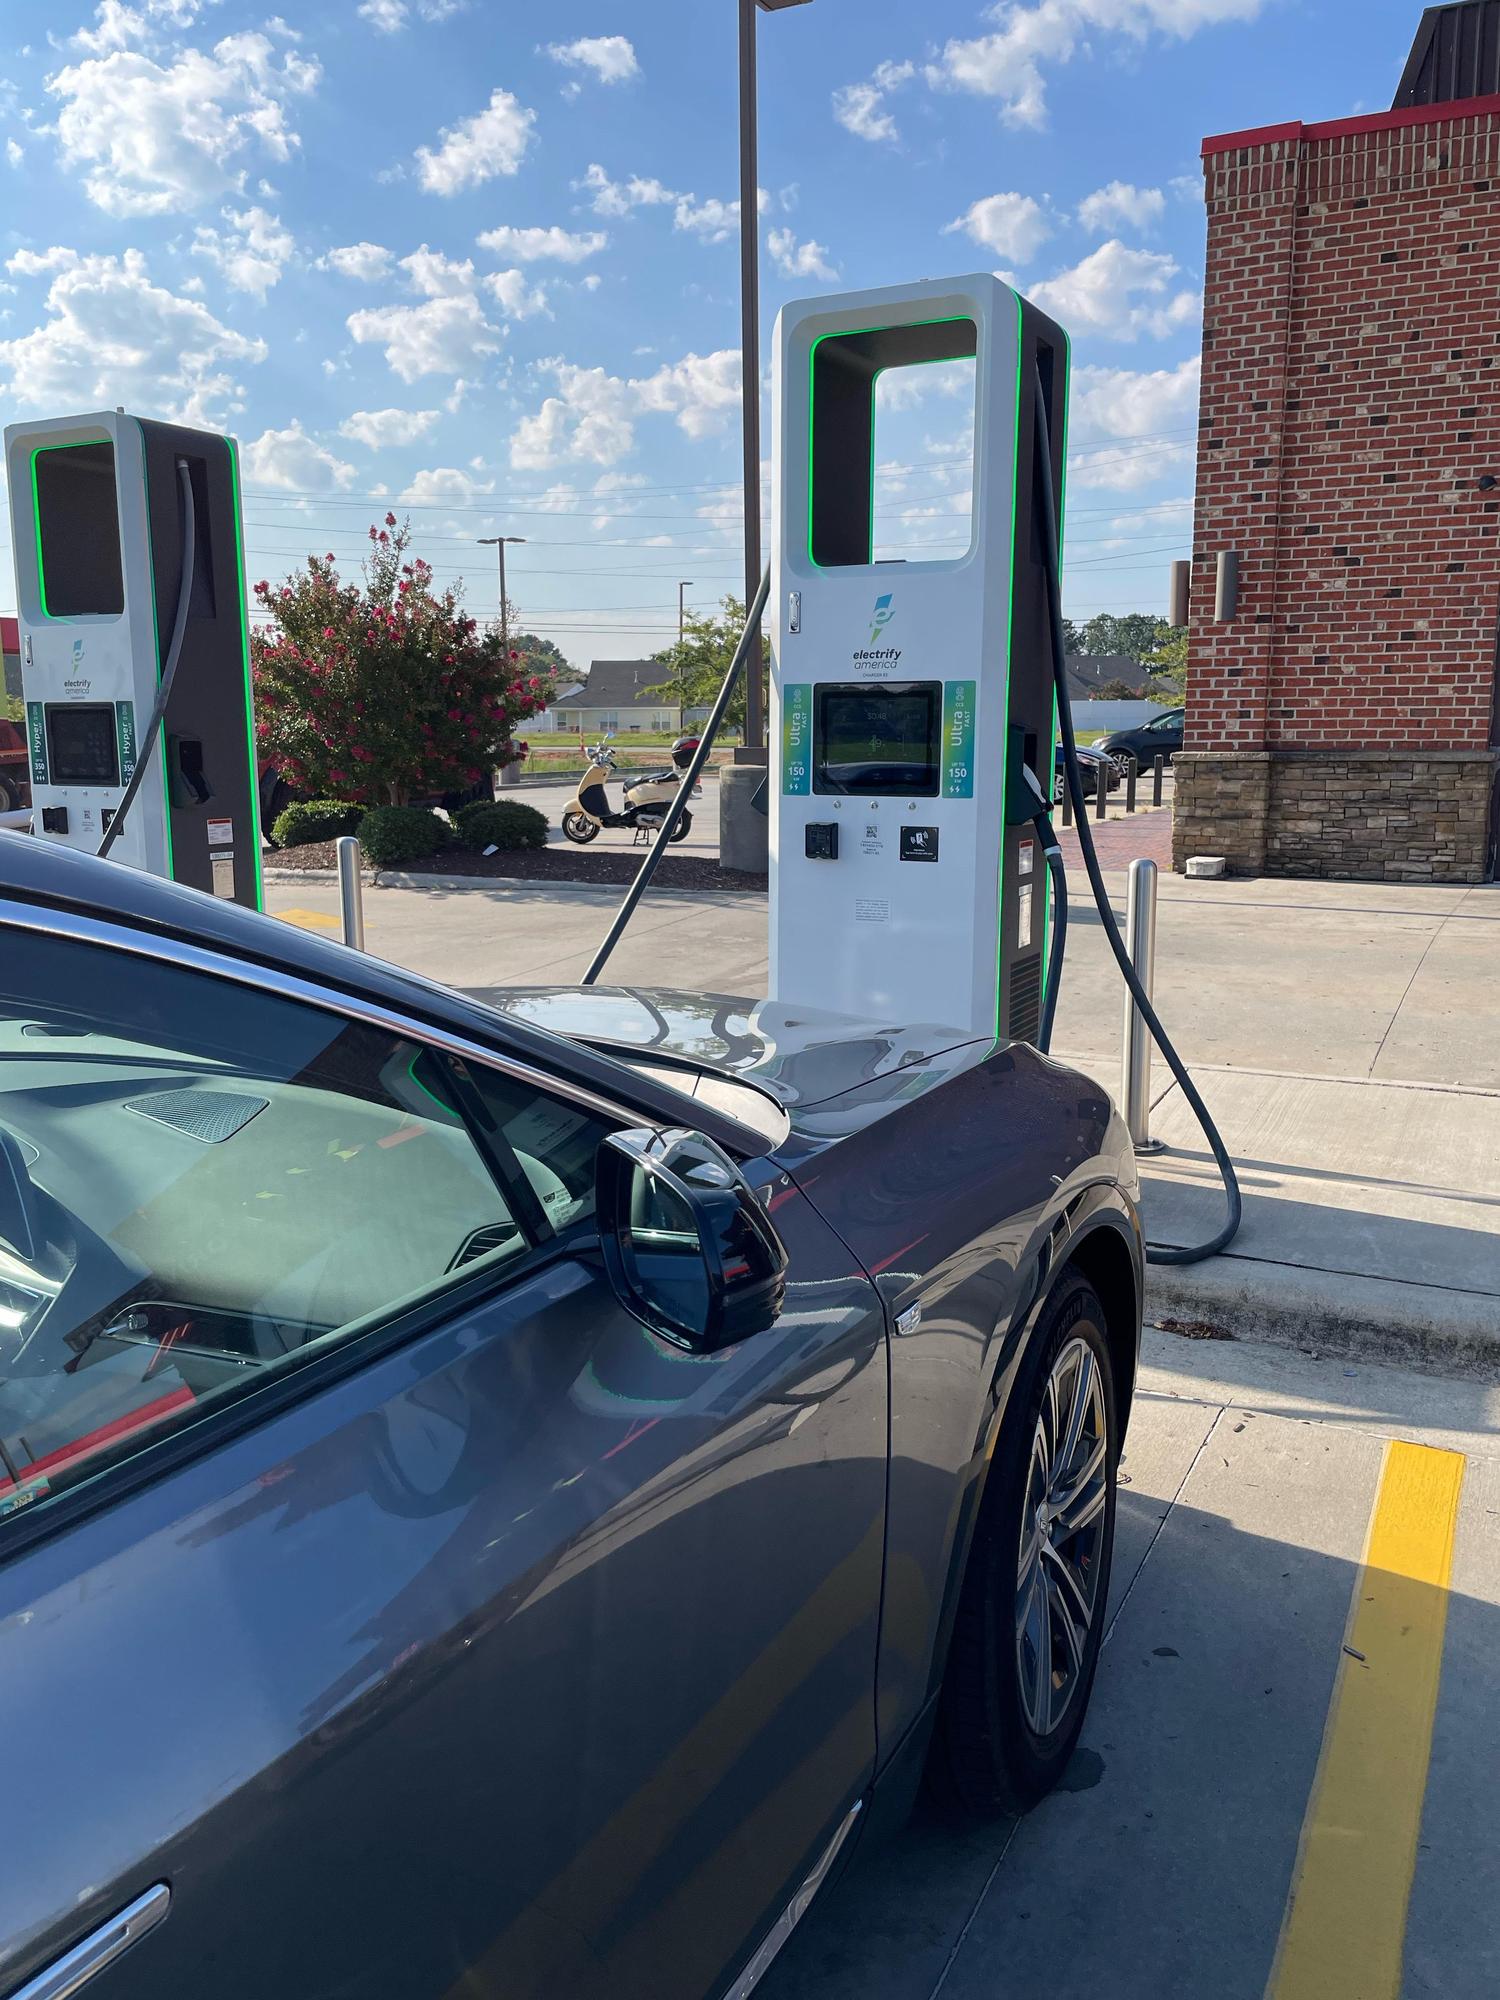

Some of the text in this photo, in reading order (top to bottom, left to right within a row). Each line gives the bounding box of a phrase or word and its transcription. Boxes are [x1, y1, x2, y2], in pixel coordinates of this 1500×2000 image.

[853, 649, 901, 660] electrify
[854, 660, 897, 669] america
[64, 680, 91, 688] electrify
[789, 712, 800, 746] Ultra
[950, 711, 963, 746] Ultra
[33, 722, 42, 753] Hyper
[122, 722, 131, 754] Hyper
[788, 766, 805, 776] 150
[948, 768, 967, 778] 150
